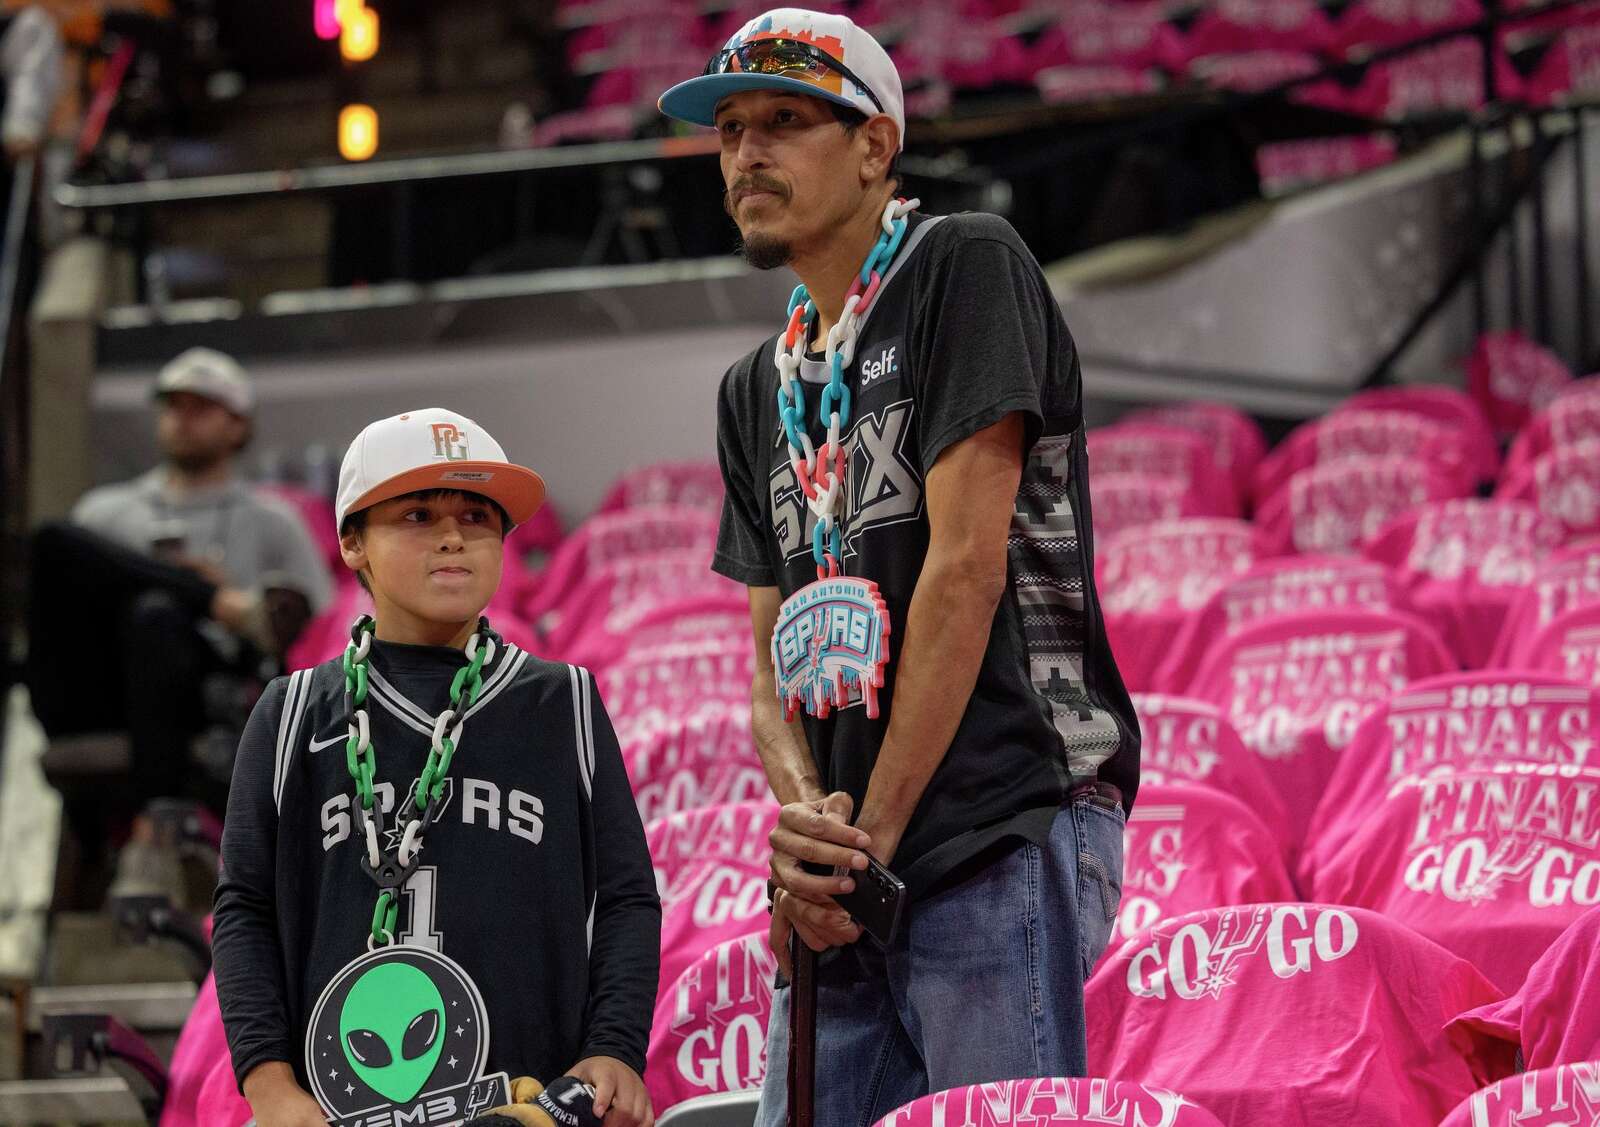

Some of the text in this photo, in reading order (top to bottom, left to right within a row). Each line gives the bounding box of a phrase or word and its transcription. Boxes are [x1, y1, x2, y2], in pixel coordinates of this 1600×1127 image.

[861, 346, 898, 386] Self.
[430, 423, 467, 460] PG
[784, 584, 865, 616] SAN ANTONIO
[1388, 706, 1593, 781] FINALS
[693, 866, 769, 927] GO
[1404, 835, 1600, 908] GO GO
[401, 866, 444, 953] 1
[671, 935, 777, 1029] FIN
[1126, 923, 1213, 1000] GO
[1265, 906, 1359, 979] GO
[676, 1013, 766, 1092] GO
